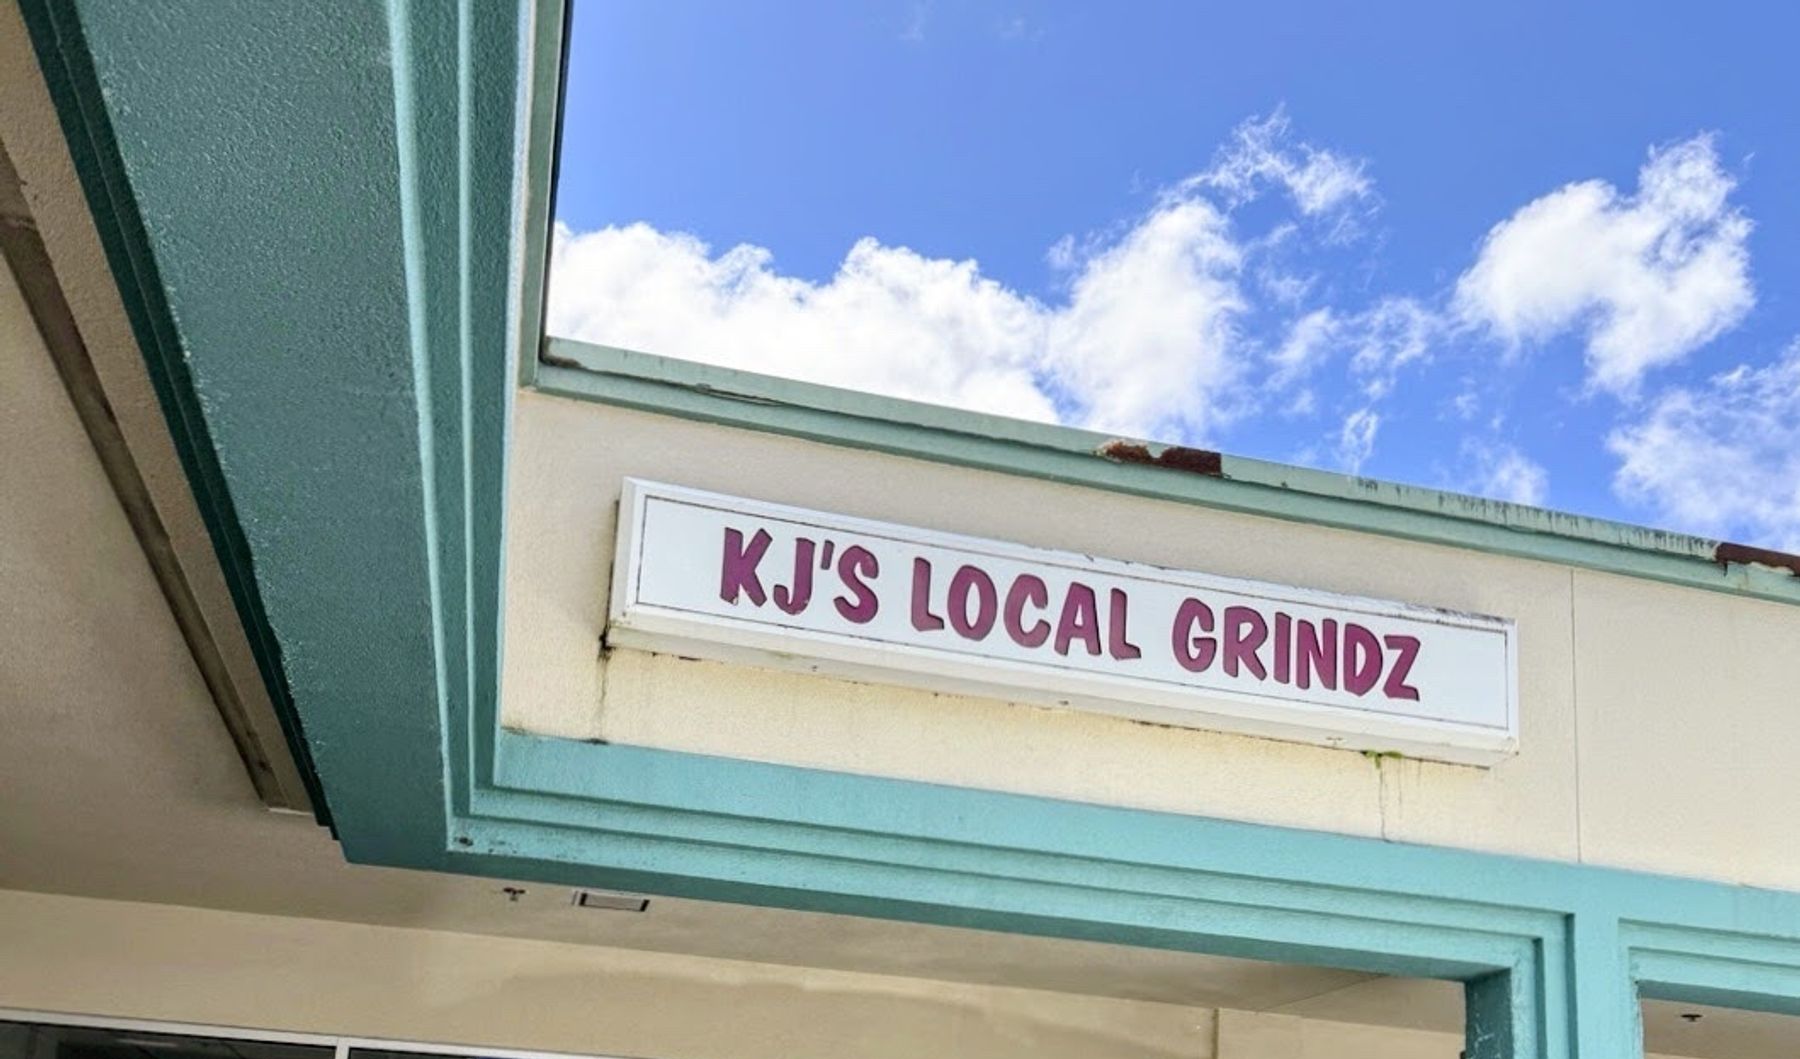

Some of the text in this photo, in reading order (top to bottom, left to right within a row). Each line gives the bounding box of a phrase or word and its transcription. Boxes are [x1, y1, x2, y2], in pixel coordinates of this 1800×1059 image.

[720, 526, 1421, 702] KJ'S LOCAL GRINDZ
